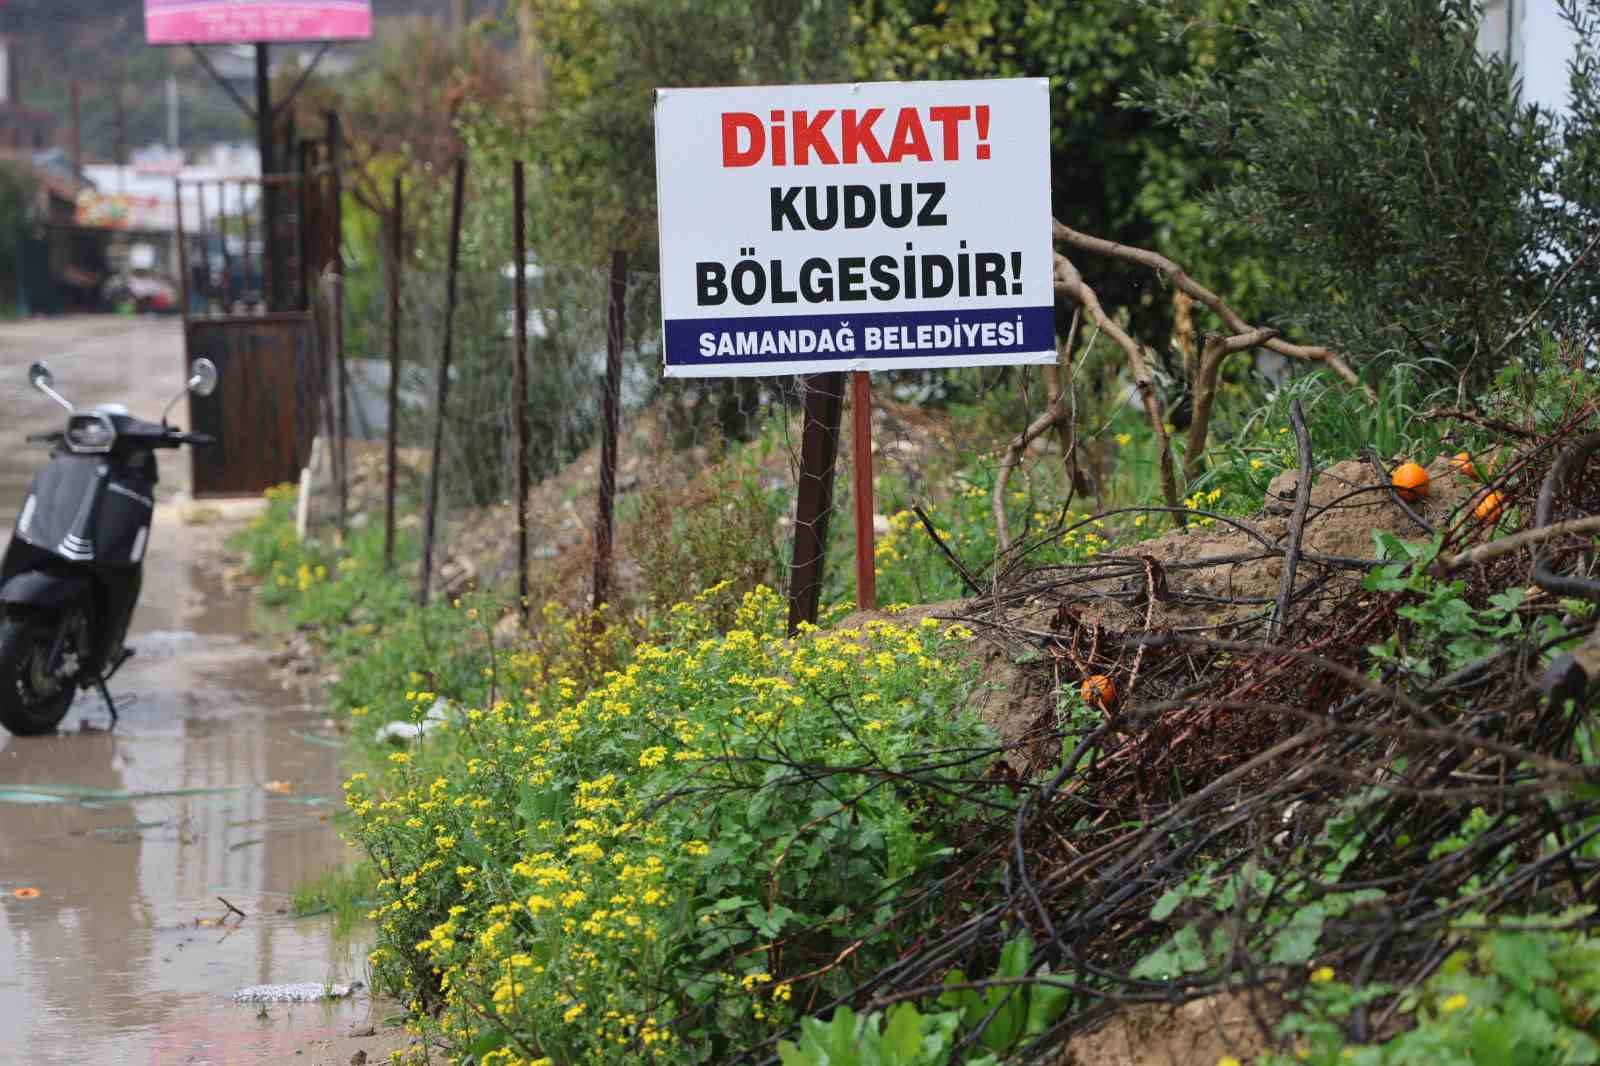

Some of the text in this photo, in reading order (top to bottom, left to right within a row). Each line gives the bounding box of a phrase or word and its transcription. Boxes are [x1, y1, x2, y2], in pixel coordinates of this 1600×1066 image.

[770, 182, 948, 232] KUDUZ
[695, 240, 1023, 307] BÖLGESİDİR!
[699, 315, 1024, 357] SAMANDAĞ BELEDİYESİ
